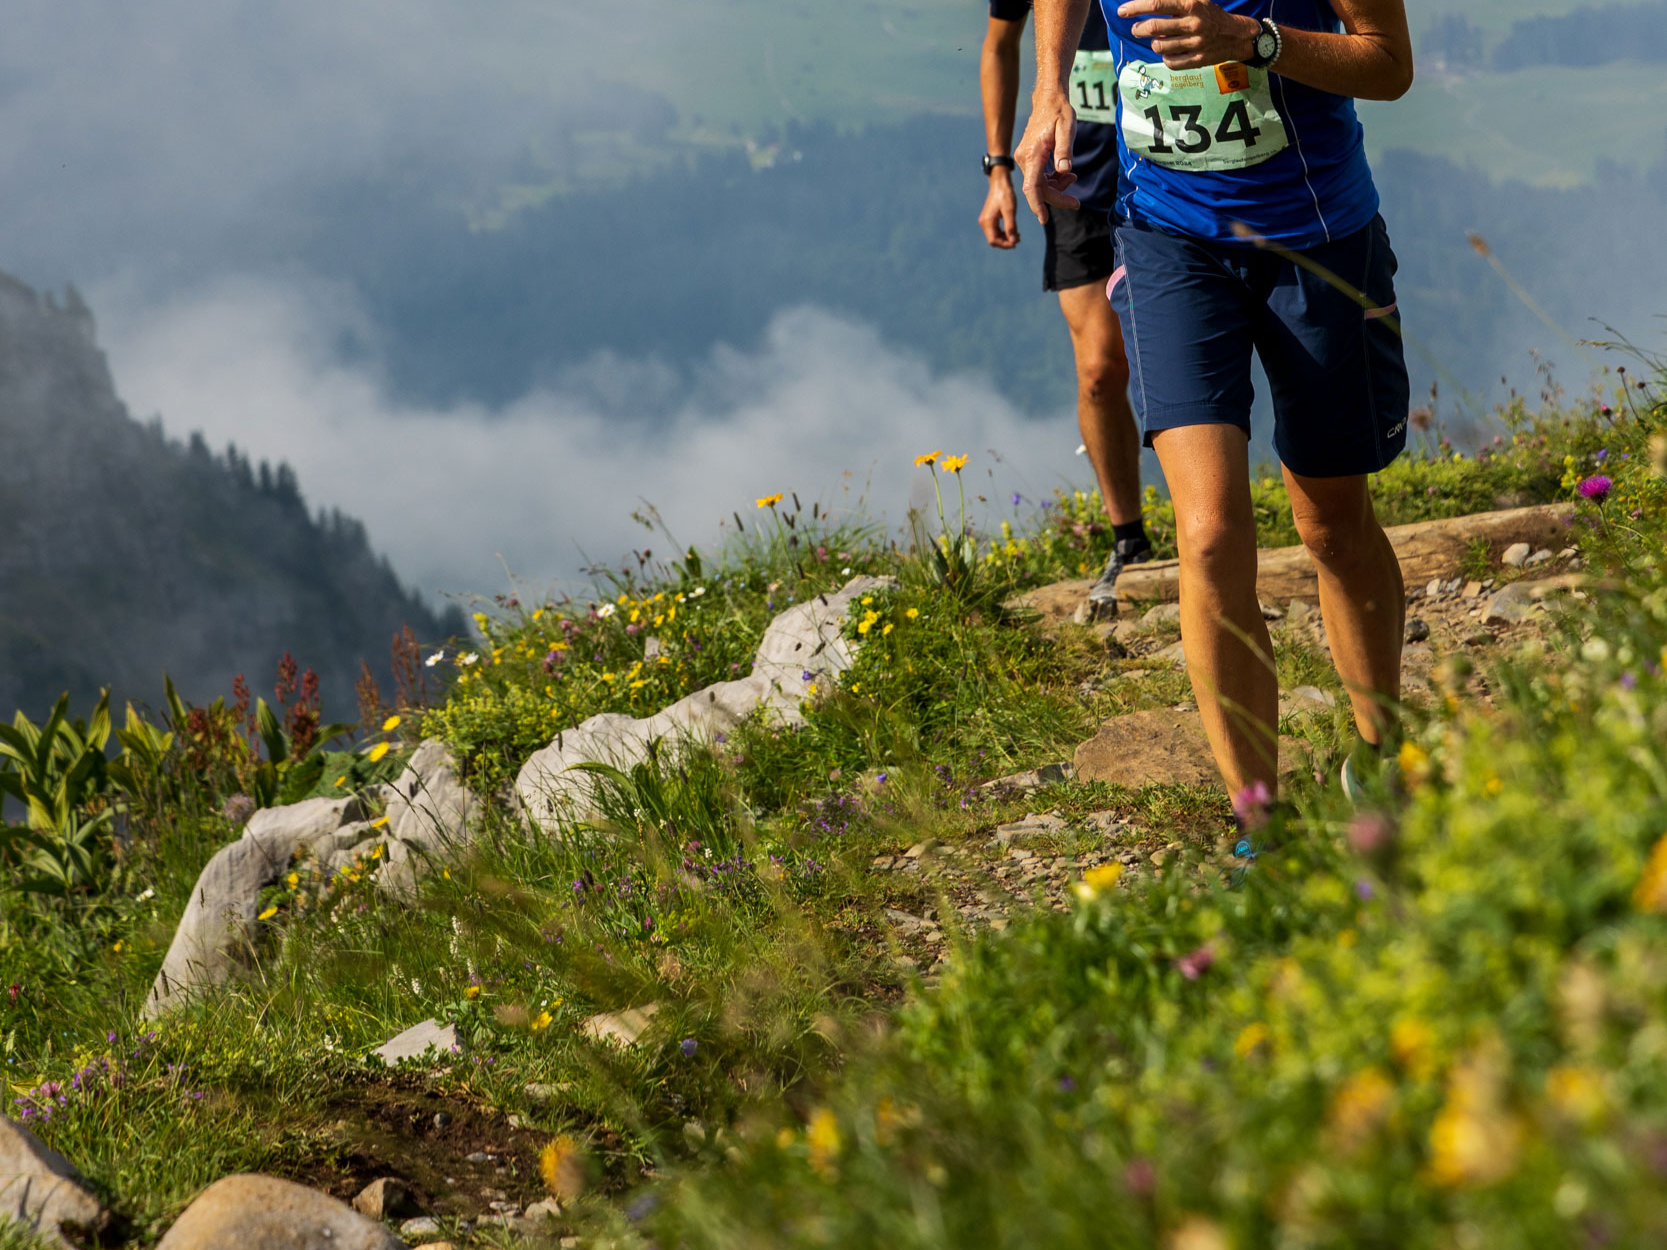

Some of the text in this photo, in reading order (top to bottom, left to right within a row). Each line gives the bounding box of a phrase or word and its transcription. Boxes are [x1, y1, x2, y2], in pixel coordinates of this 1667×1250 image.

[1170, 73, 1202, 83] berglauf
[1171, 82, 1204, 90] engelberg
[1144, 99, 1261, 154] 134
